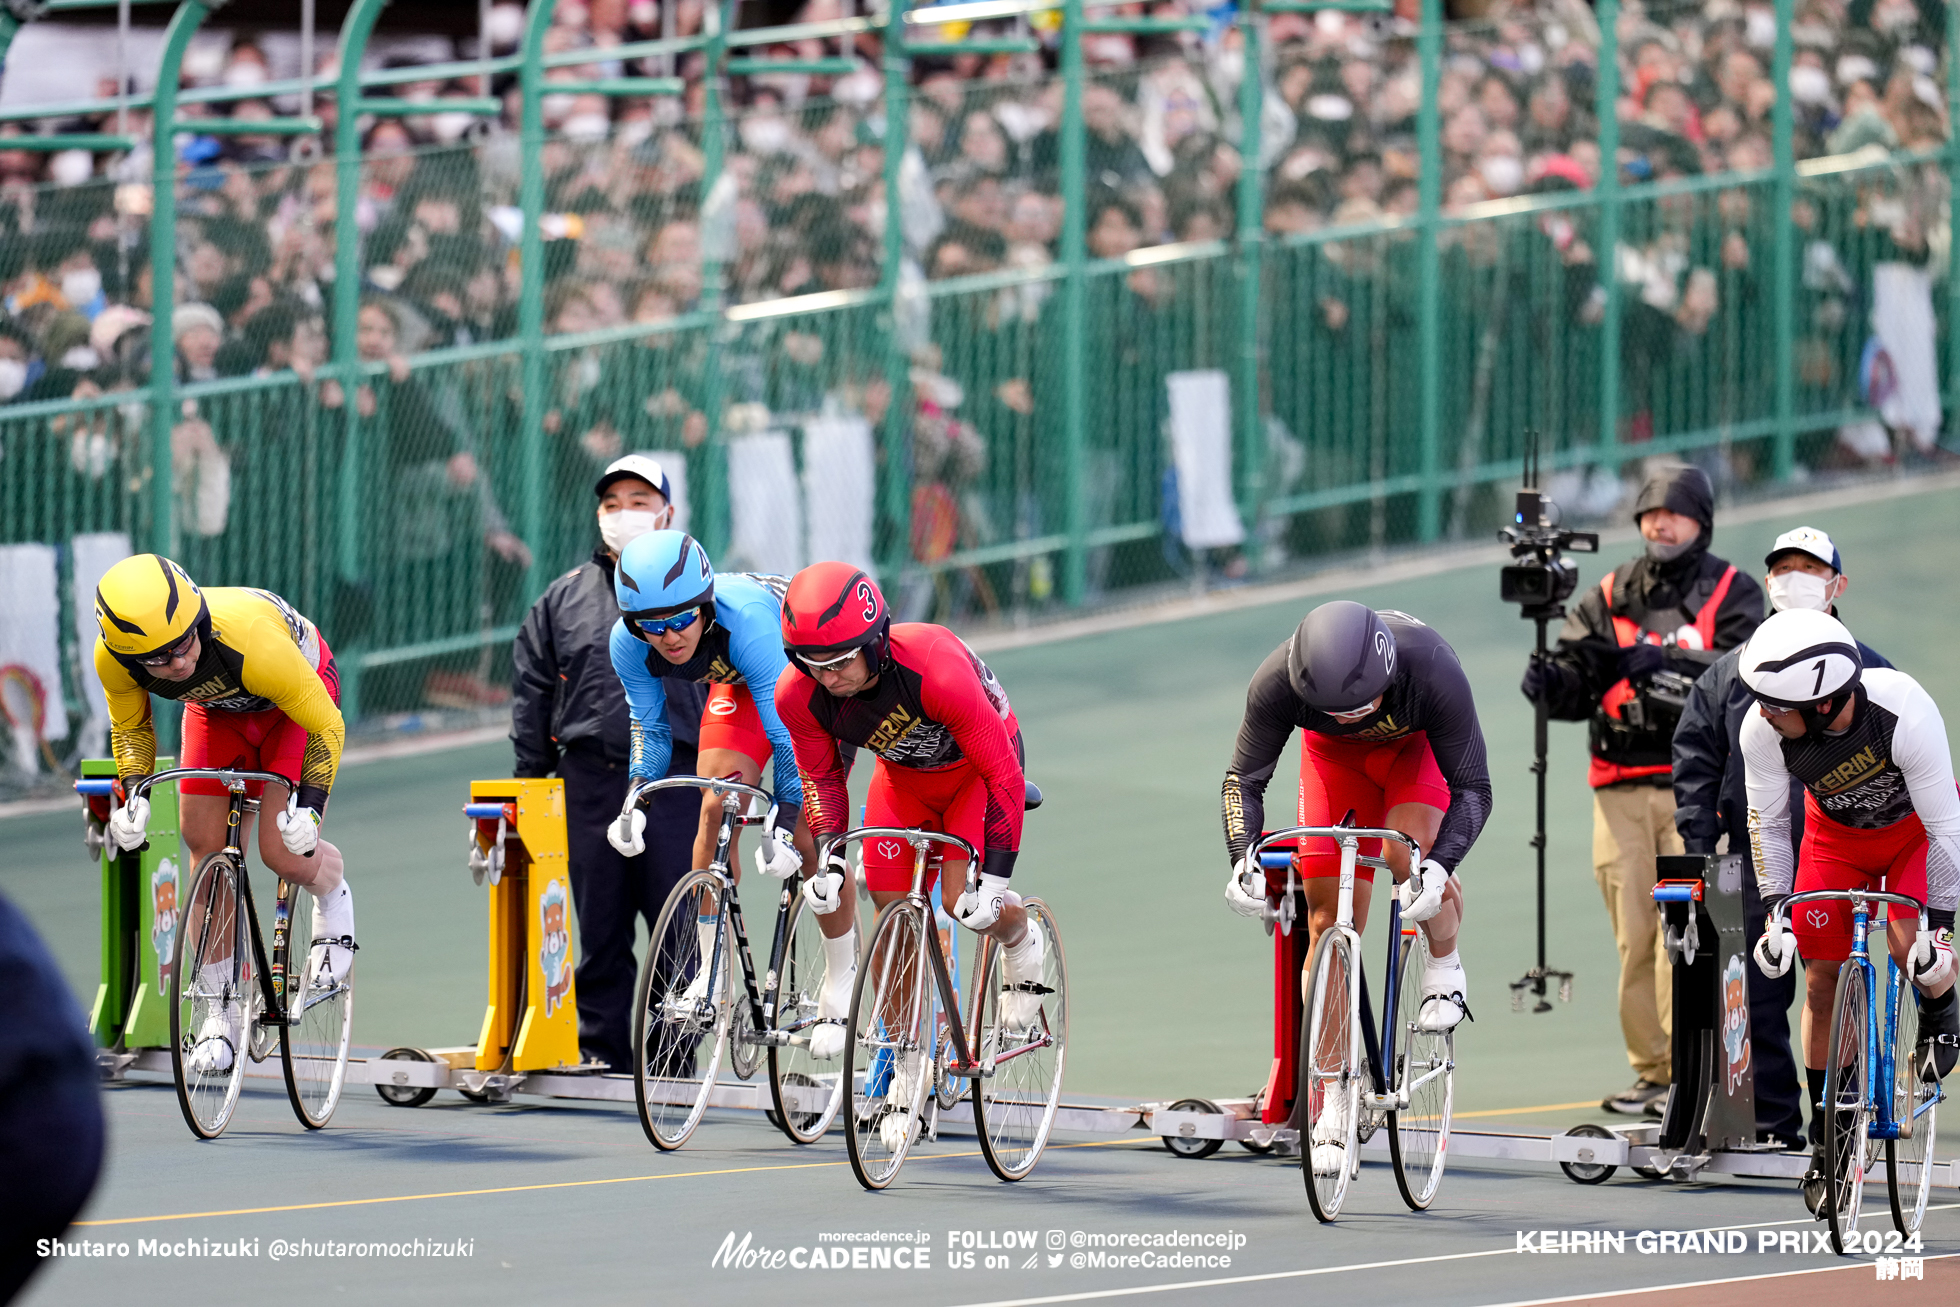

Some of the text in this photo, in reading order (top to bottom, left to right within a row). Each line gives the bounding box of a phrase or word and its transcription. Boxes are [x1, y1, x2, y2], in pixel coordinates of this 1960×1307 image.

[693, 542, 712, 583] 4
[857, 582, 878, 622] 3
[1375, 631, 1395, 675] 2
[177, 676, 226, 701] EIRIN
[1812, 658, 1826, 696] 1
[1808, 745, 1877, 792] KEIRIN
